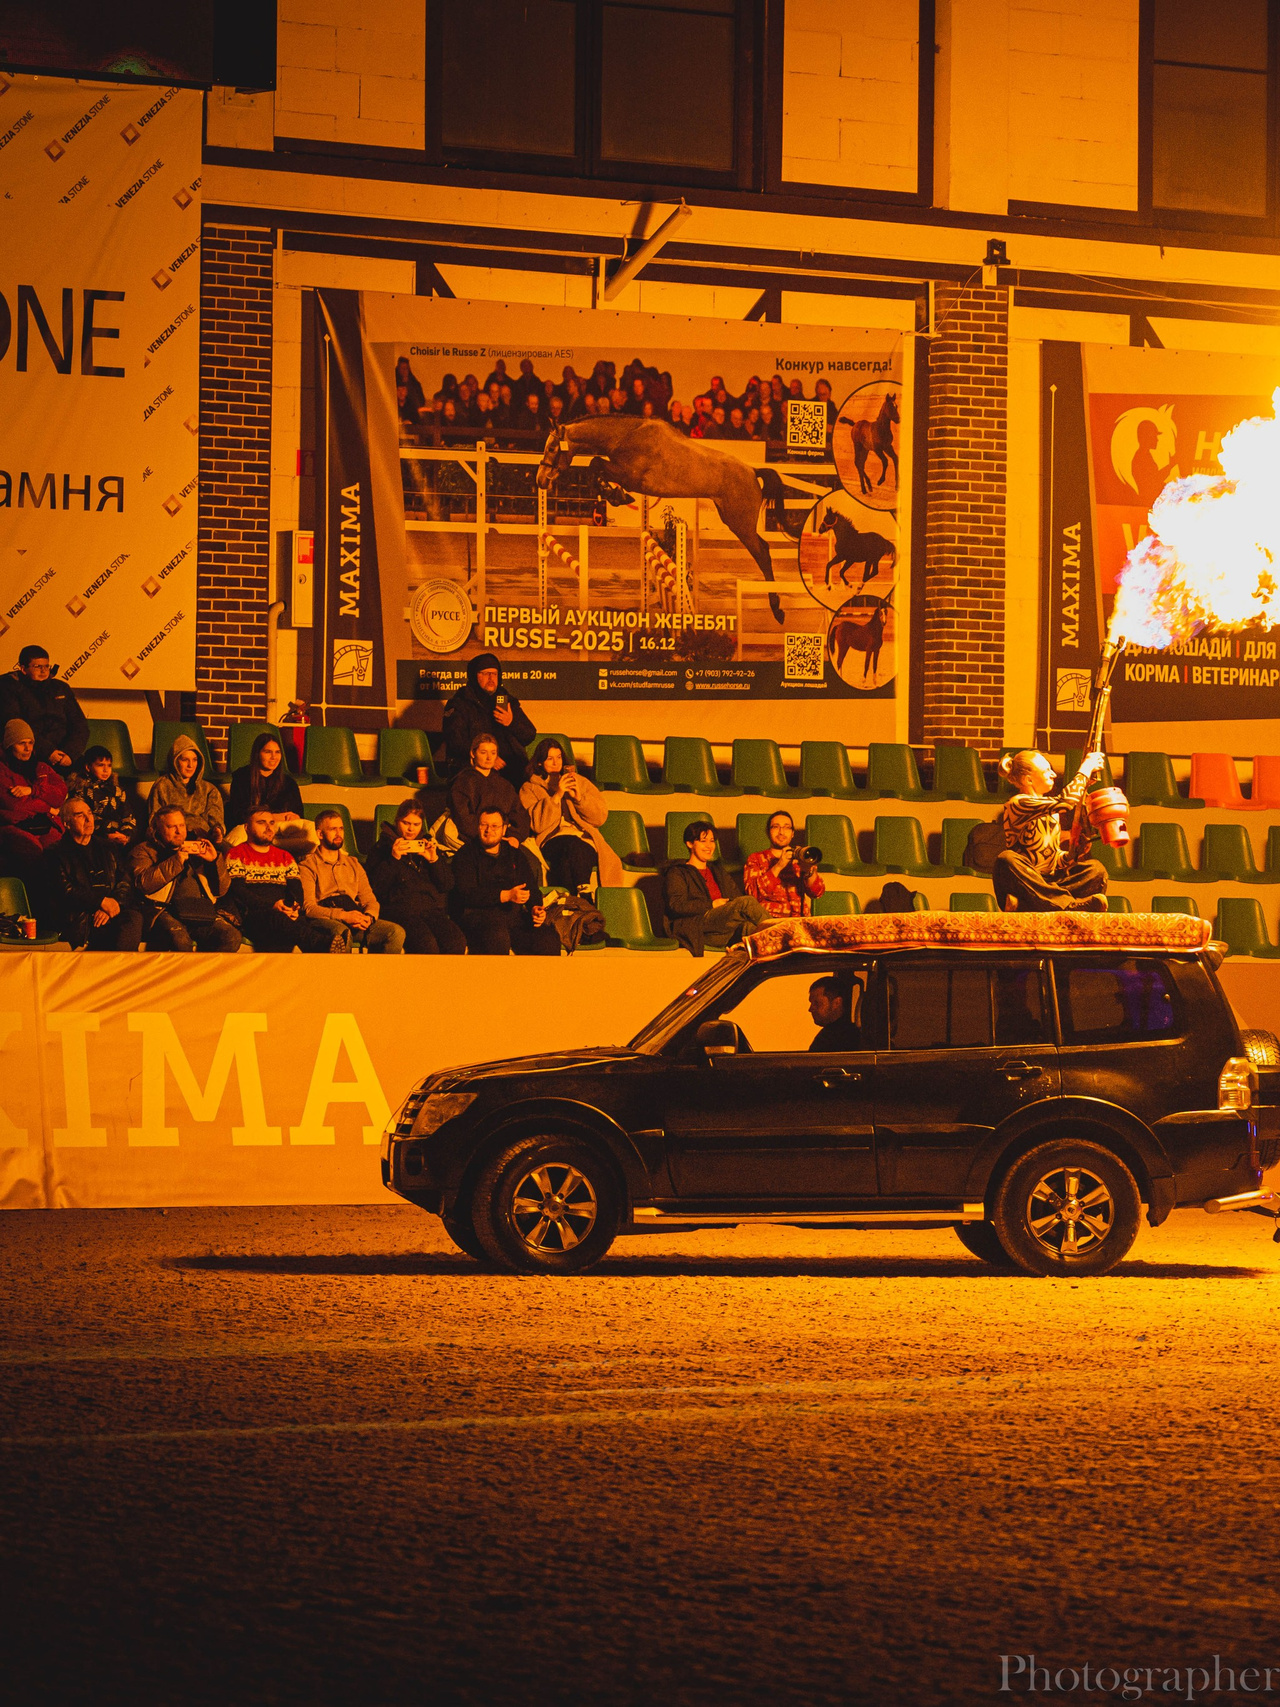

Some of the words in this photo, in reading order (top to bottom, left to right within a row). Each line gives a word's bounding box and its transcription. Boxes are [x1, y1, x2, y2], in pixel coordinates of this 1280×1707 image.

[12, 110, 34, 134] STONE
[62, 114, 92, 144] VENEZIA
[88, 94, 112, 118] STONE
[137, 98, 168, 128] VENEZIA
[164, 86, 182, 100] STO
[68, 175, 90, 198] STONE
[115, 178, 146, 208] VENEZIA
[142, 158, 165, 182] STONE
[168, 242, 198, 273] VENEZIA
[0, 284, 125, 378] NE
[146, 324, 177, 354] VENEZIA
[174, 304, 196, 327] STONE
[410, 346, 440, 356] Choisir
[442, 346, 450, 356] le
[452, 348, 478, 356] Russe
[480, 348, 486, 356] Z
[488, 348, 552, 360] (лицензирован
[554, 349, 574, 359] AES)
[776, 358, 824, 374] Конкур
[828, 358, 892, 374] навсегда!
[153, 385, 174, 408] STONE
[158, 550, 188, 580] VENEZIA
[340, 482, 360, 618] MAXIMA
[82, 569, 114, 600] VENEZIA
[110, 554, 130, 572] STON
[1062, 522, 1080, 648] MAXIMA
[6, 588, 38, 619] VENEZIA
[34, 566, 56, 591] STONE
[431, 610, 460, 621] РУССЕ
[484, 604, 560, 625] ПЕРВЫЙ
[564, 610, 650, 628] АУКЦИОН
[654, 613, 738, 632] ЖЕРЕБЯТ
[136, 631, 167, 662] VENEZIA
[164, 610, 186, 634] STONE
[640, 636, 676, 650] 16.12
[1244, 640, 1276, 662] ДЛЯ
[61, 651, 92, 682] VENEZIA
[88, 630, 111, 654] STONE
[420, 670, 452, 680] Всегда
[502, 672, 520, 680] ами
[522, 672, 528, 680] в
[530, 670, 541, 680] 20
[544, 672, 556, 680] км
[704, 670, 720, 678] (903)
[1125, 663, 1180, 683] КОРМА
